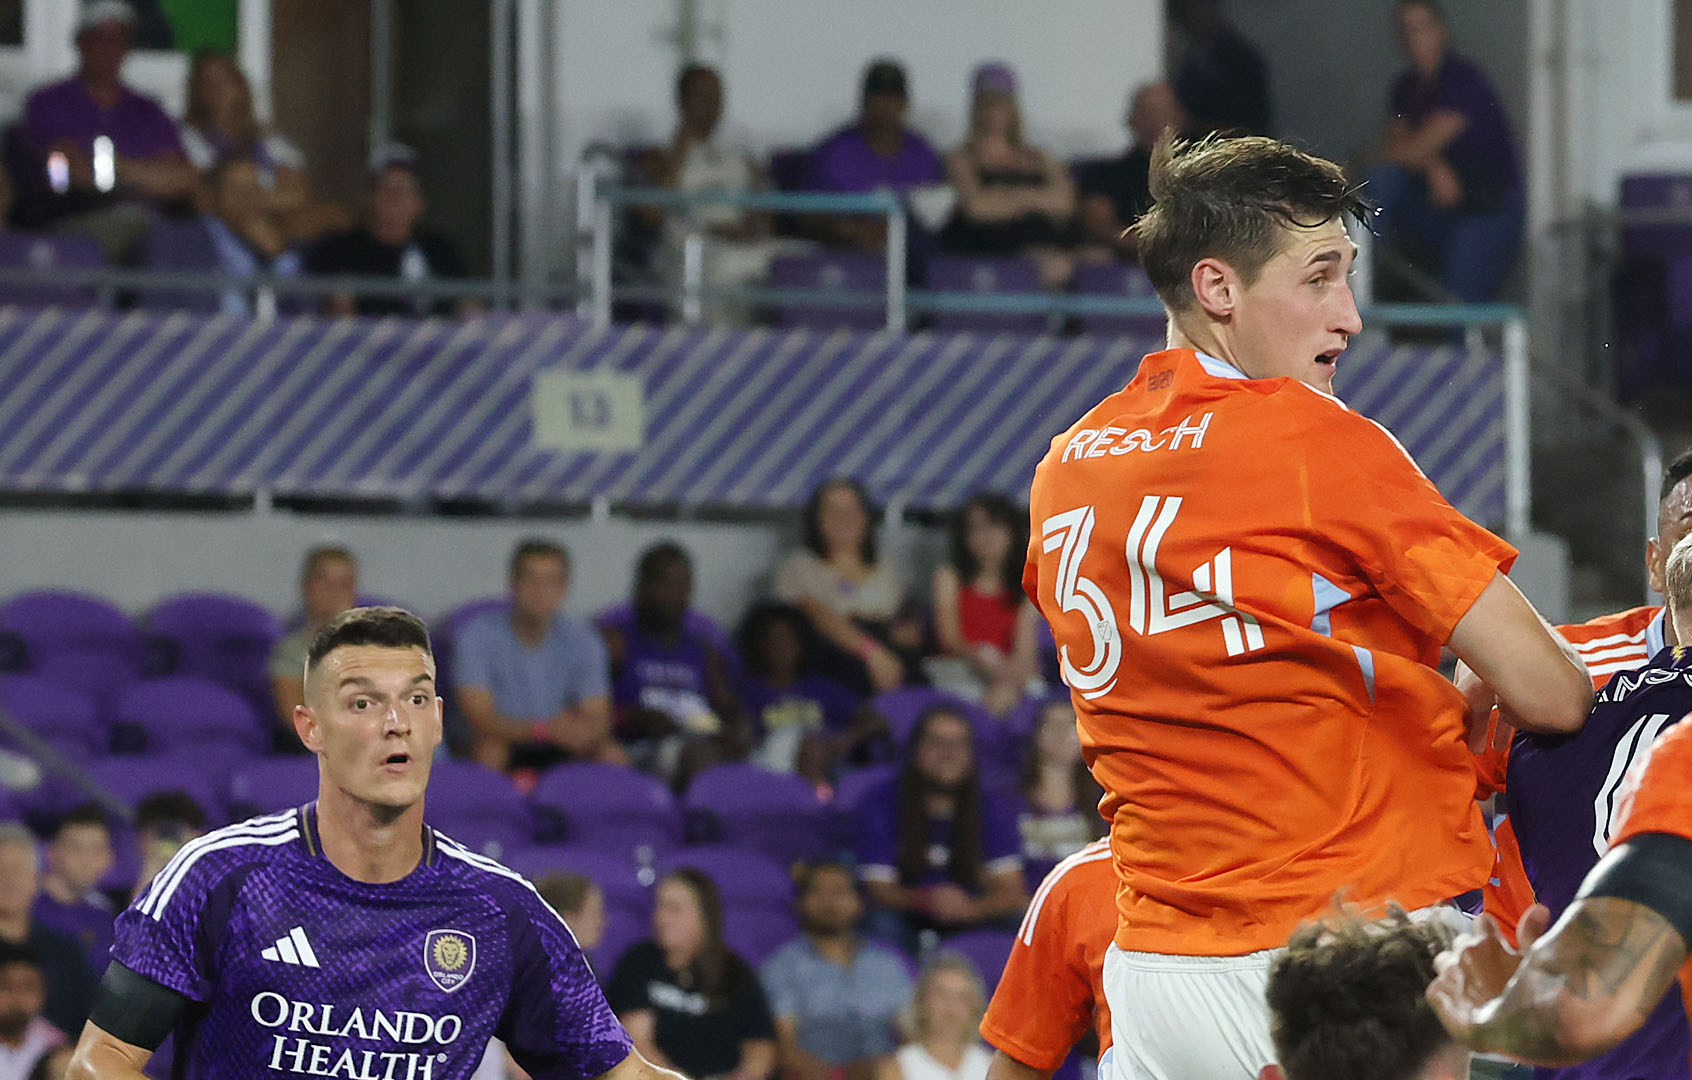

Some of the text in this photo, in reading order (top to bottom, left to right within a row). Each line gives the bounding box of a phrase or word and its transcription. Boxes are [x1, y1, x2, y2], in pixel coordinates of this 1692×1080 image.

[1061, 411, 1214, 464] RESCH
[1042, 495, 1265, 700] 34
[251, 991, 462, 1045] ORLANDO
